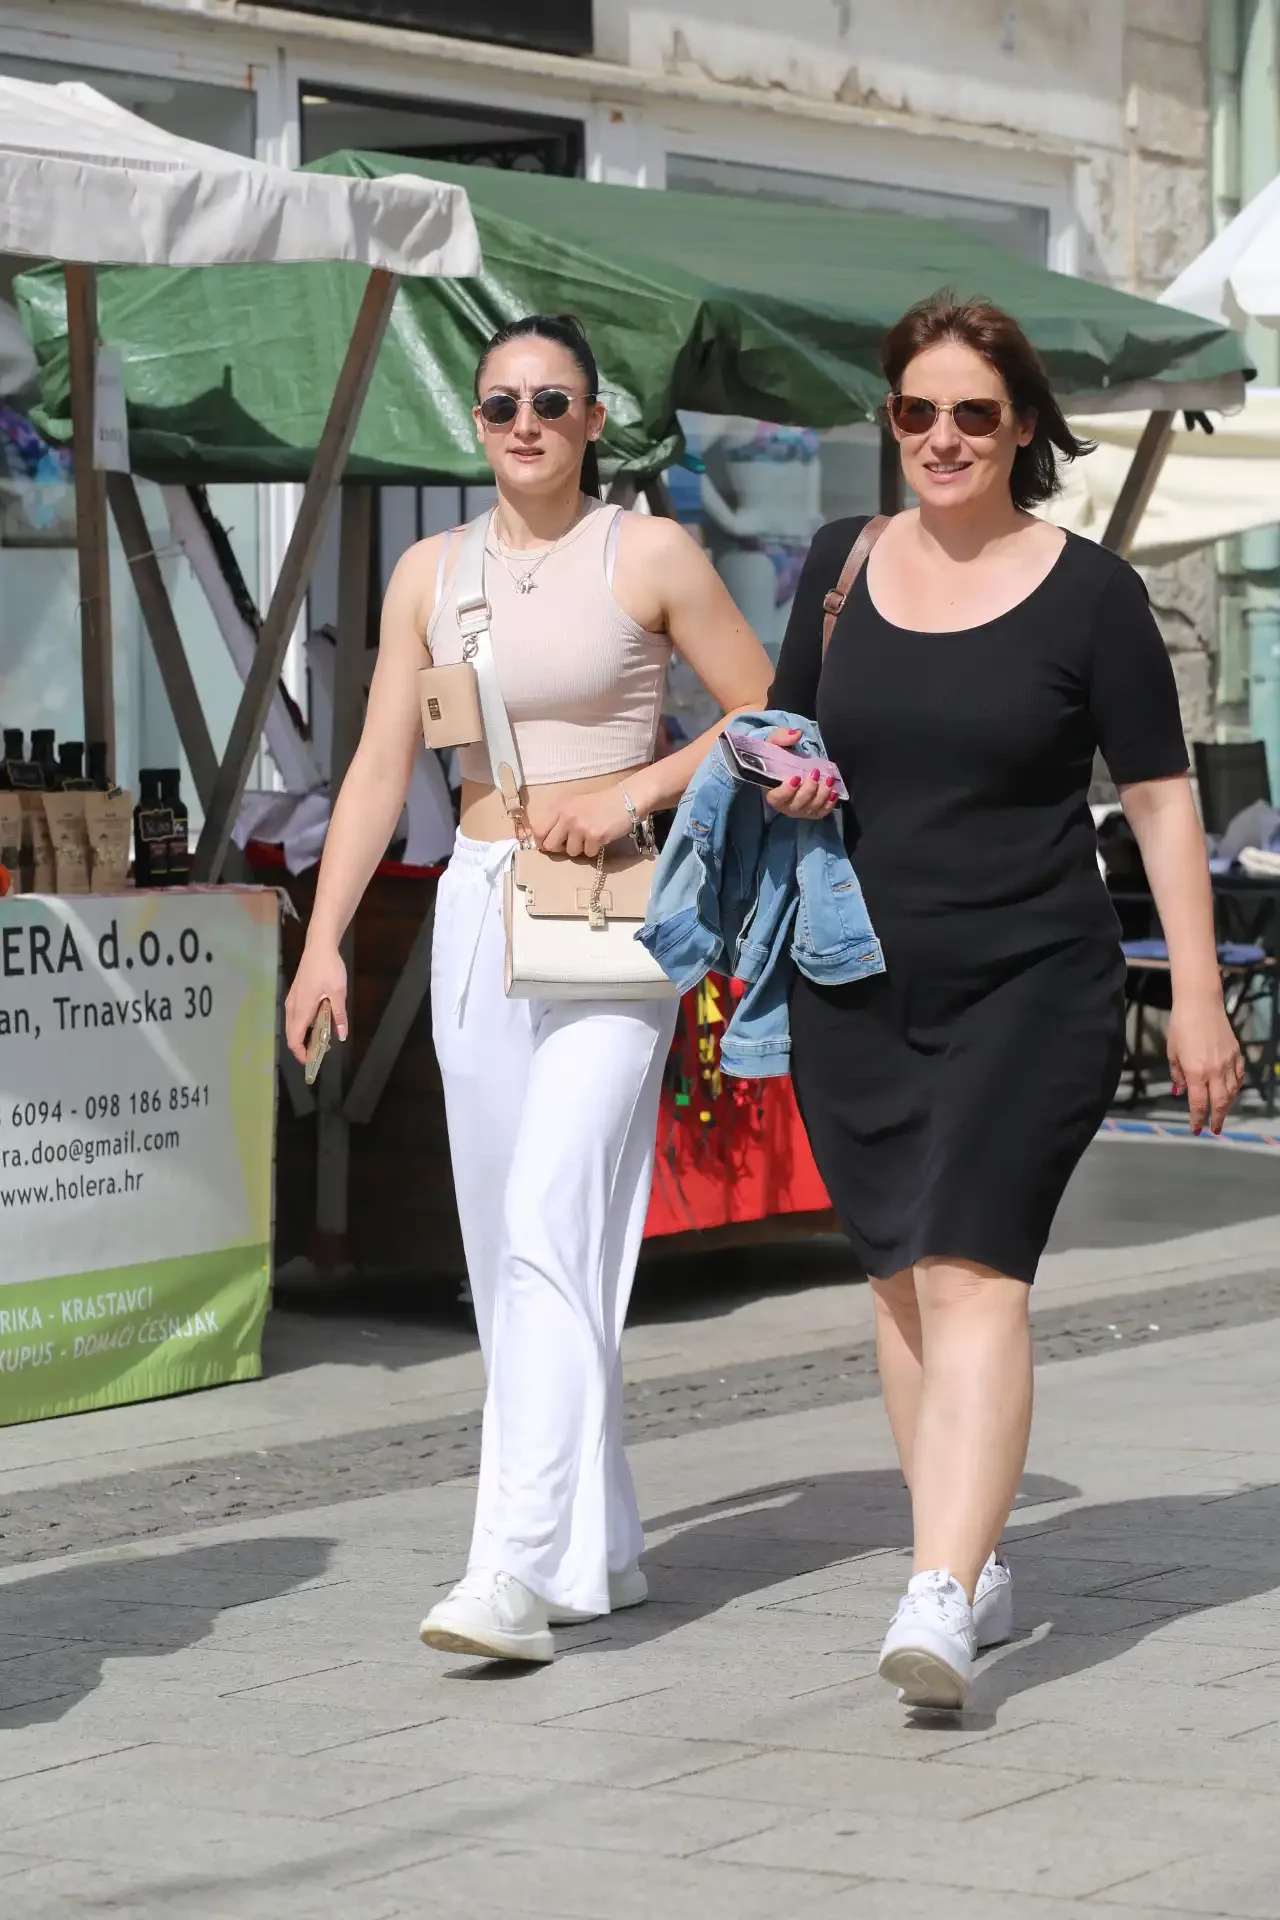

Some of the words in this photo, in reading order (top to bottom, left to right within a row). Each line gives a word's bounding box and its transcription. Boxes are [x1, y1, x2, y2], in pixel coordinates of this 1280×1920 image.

[3, 923, 83, 977] ERA
[98, 919, 214, 970] d.o.o.
[53, 990, 172, 1031] Trnavska
[185, 986, 213, 1019] 30
[12, 1099, 62, 1127] 6094
[85, 1094, 121, 1120] 098
[130, 1089, 162, 1115] 186
[169, 1084, 210, 1110] 8541
[2, 1129, 180, 1168] ra.doo@gmail.com
[0, 1169, 144, 1207] www.holera.hr
[0, 1305, 42, 1336] RIKA
[61, 1285, 153, 1326] KRASTAVCI
